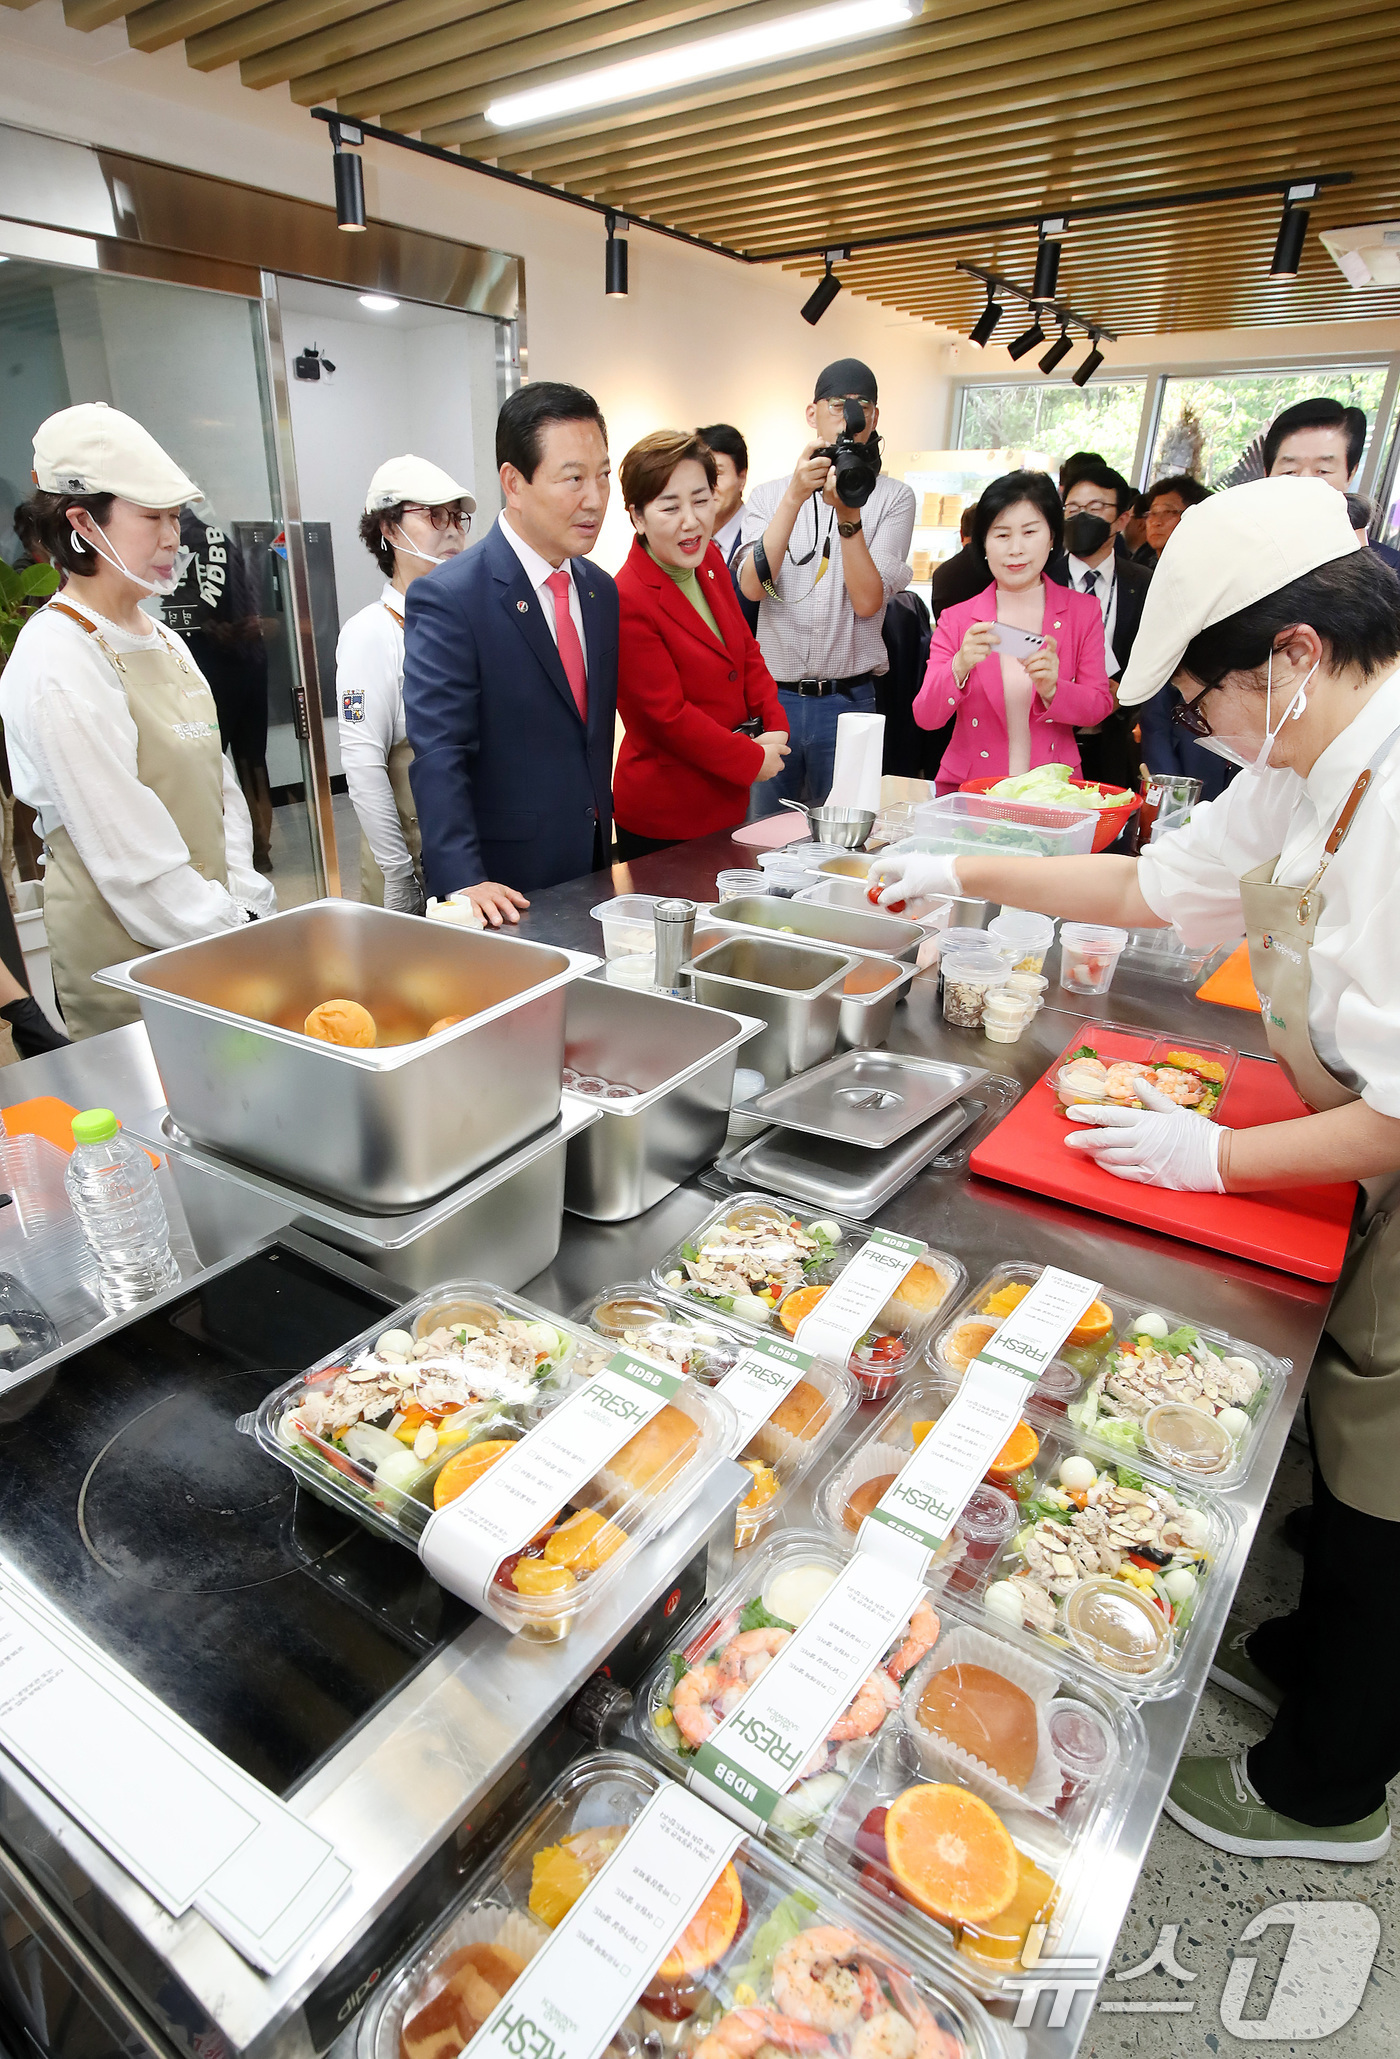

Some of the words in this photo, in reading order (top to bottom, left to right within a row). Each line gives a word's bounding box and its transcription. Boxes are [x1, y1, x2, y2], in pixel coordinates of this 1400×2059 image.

[881, 1236, 910, 1250] MDBB
[861, 1249, 908, 1271] FRESH
[767, 1344, 798, 1362] MDBB
[994, 1334, 1049, 1362] FRESH
[624, 1362, 662, 1387] MDBB
[740, 1361, 792, 1390] FRESH
[581, 1384, 649, 1425] FRESH
[892, 1483, 955, 1521] FRESH
[766, 1706, 800, 1731] SANDWICH
[769, 1715, 791, 1732] SALAD
[729, 1710, 803, 1772] FRESH
[714, 1762, 758, 1802] MDBB
[592, 1905, 613, 1925] 샐러드
[610, 1920, 639, 1946] 닭가슴살
[491, 2004, 566, 2059] ESH
